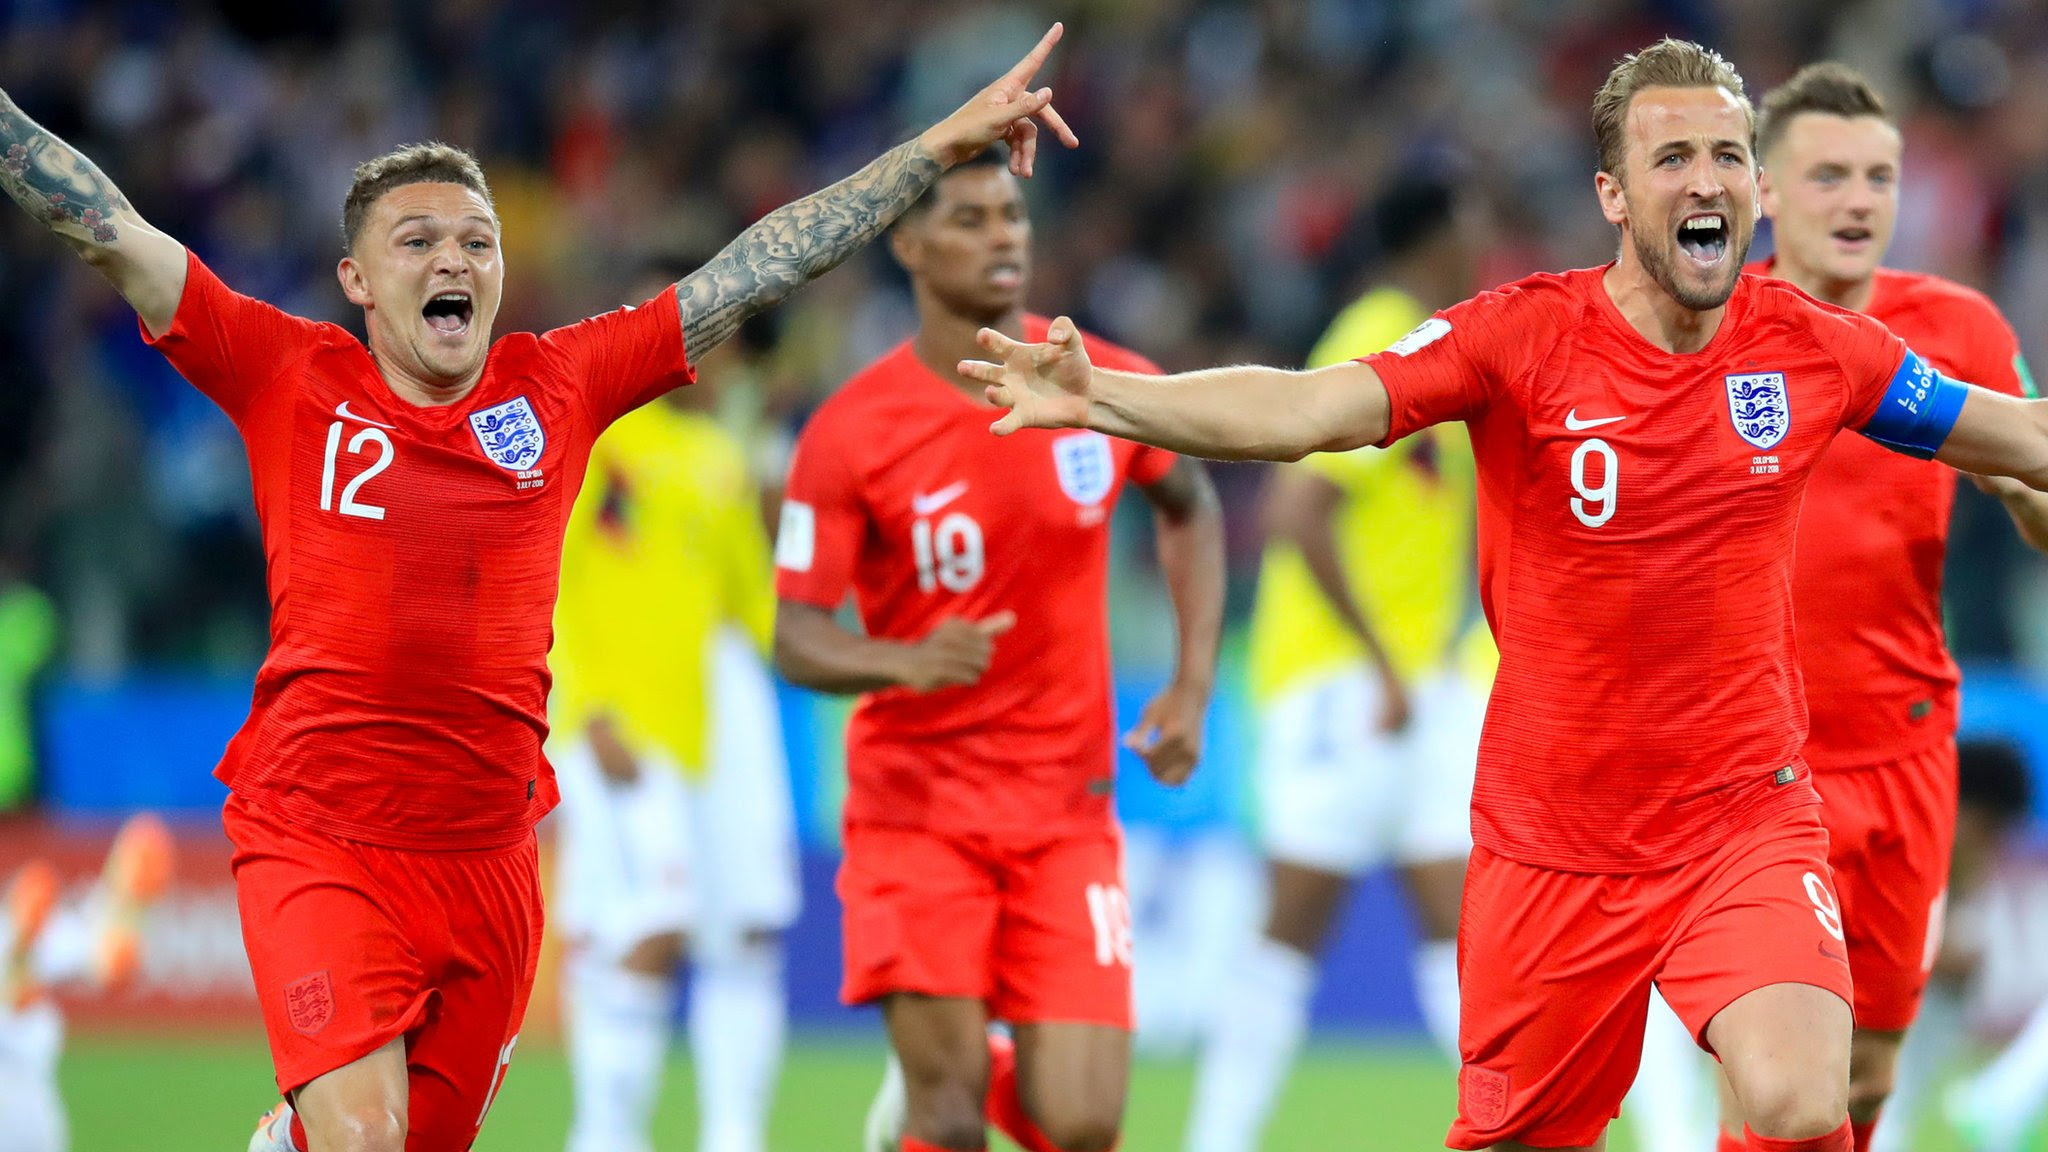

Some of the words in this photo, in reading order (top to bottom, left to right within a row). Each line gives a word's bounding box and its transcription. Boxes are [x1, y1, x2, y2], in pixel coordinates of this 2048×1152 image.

[320, 420, 395, 520] 12
[517, 469, 544, 480] COLOMBIA
[1570, 438, 1618, 528] 9
[1752, 455, 1779, 465] COLOMBIA
[1802, 871, 1844, 941] 9
